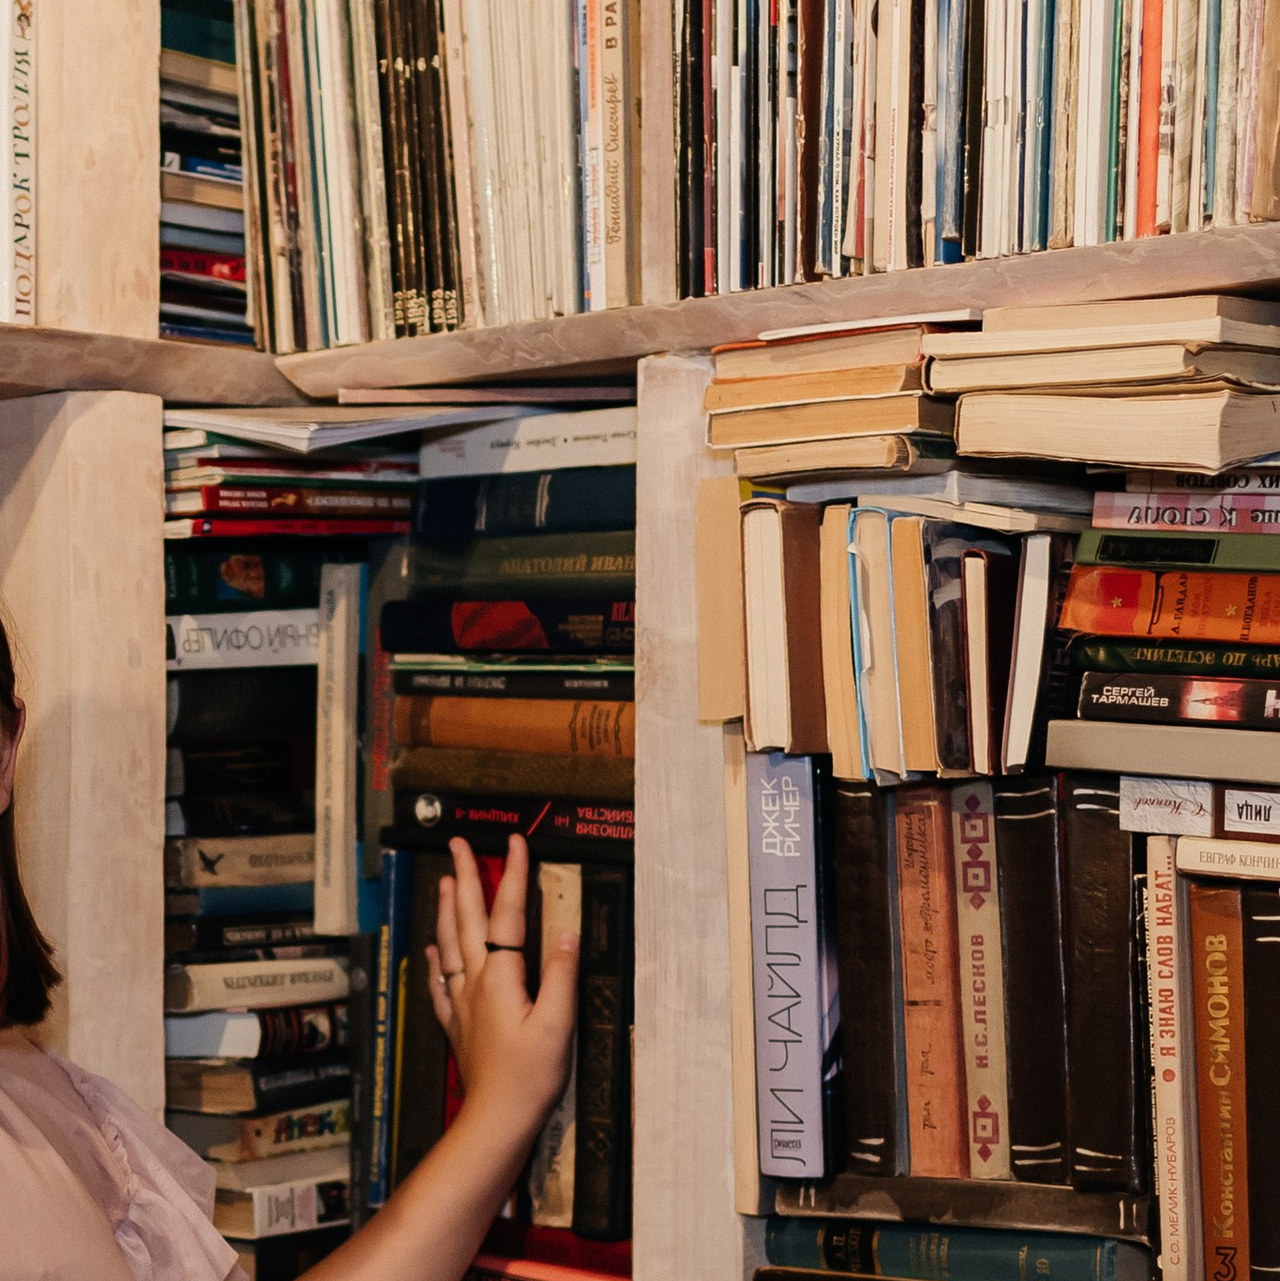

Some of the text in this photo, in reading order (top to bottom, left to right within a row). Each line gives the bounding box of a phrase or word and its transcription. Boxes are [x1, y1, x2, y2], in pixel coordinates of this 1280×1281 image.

[605, 35, 618, 49] В
[12, 173, 33, 317] ПОДАРОК
[1128, 507, 1211, 526] СТОЛУ
[1174, 573, 1188, 620] ГАЙДАР
[1223, 653, 1247, 665] ПО
[1091, 694, 1169, 707] ТАРМАШЕВ
[1103, 686, 1155, 697] СЕРГЕЙ
[760, 778, 784, 857] ДЖЕК
[780, 775, 802, 858] РИЧЕР
[1236, 800, 1272, 822] ЛИЦА
[1199, 851, 1236, 865] ЕВГРАФ
[1156, 934, 1174, 979] СЛОВ
[763, 883, 808, 1167] ЛИ ЧАЙЛД
[1157, 986, 1176, 1040] ЗНАЮ
[1205, 933, 1232, 1087] СИМОНОВ
[1158, 1044, 1177, 1058] Я
[1163, 1115, 1180, 1236] МЕЛИК-НУБАРОВ
[1212, 1090, 1235, 1239] Константин
